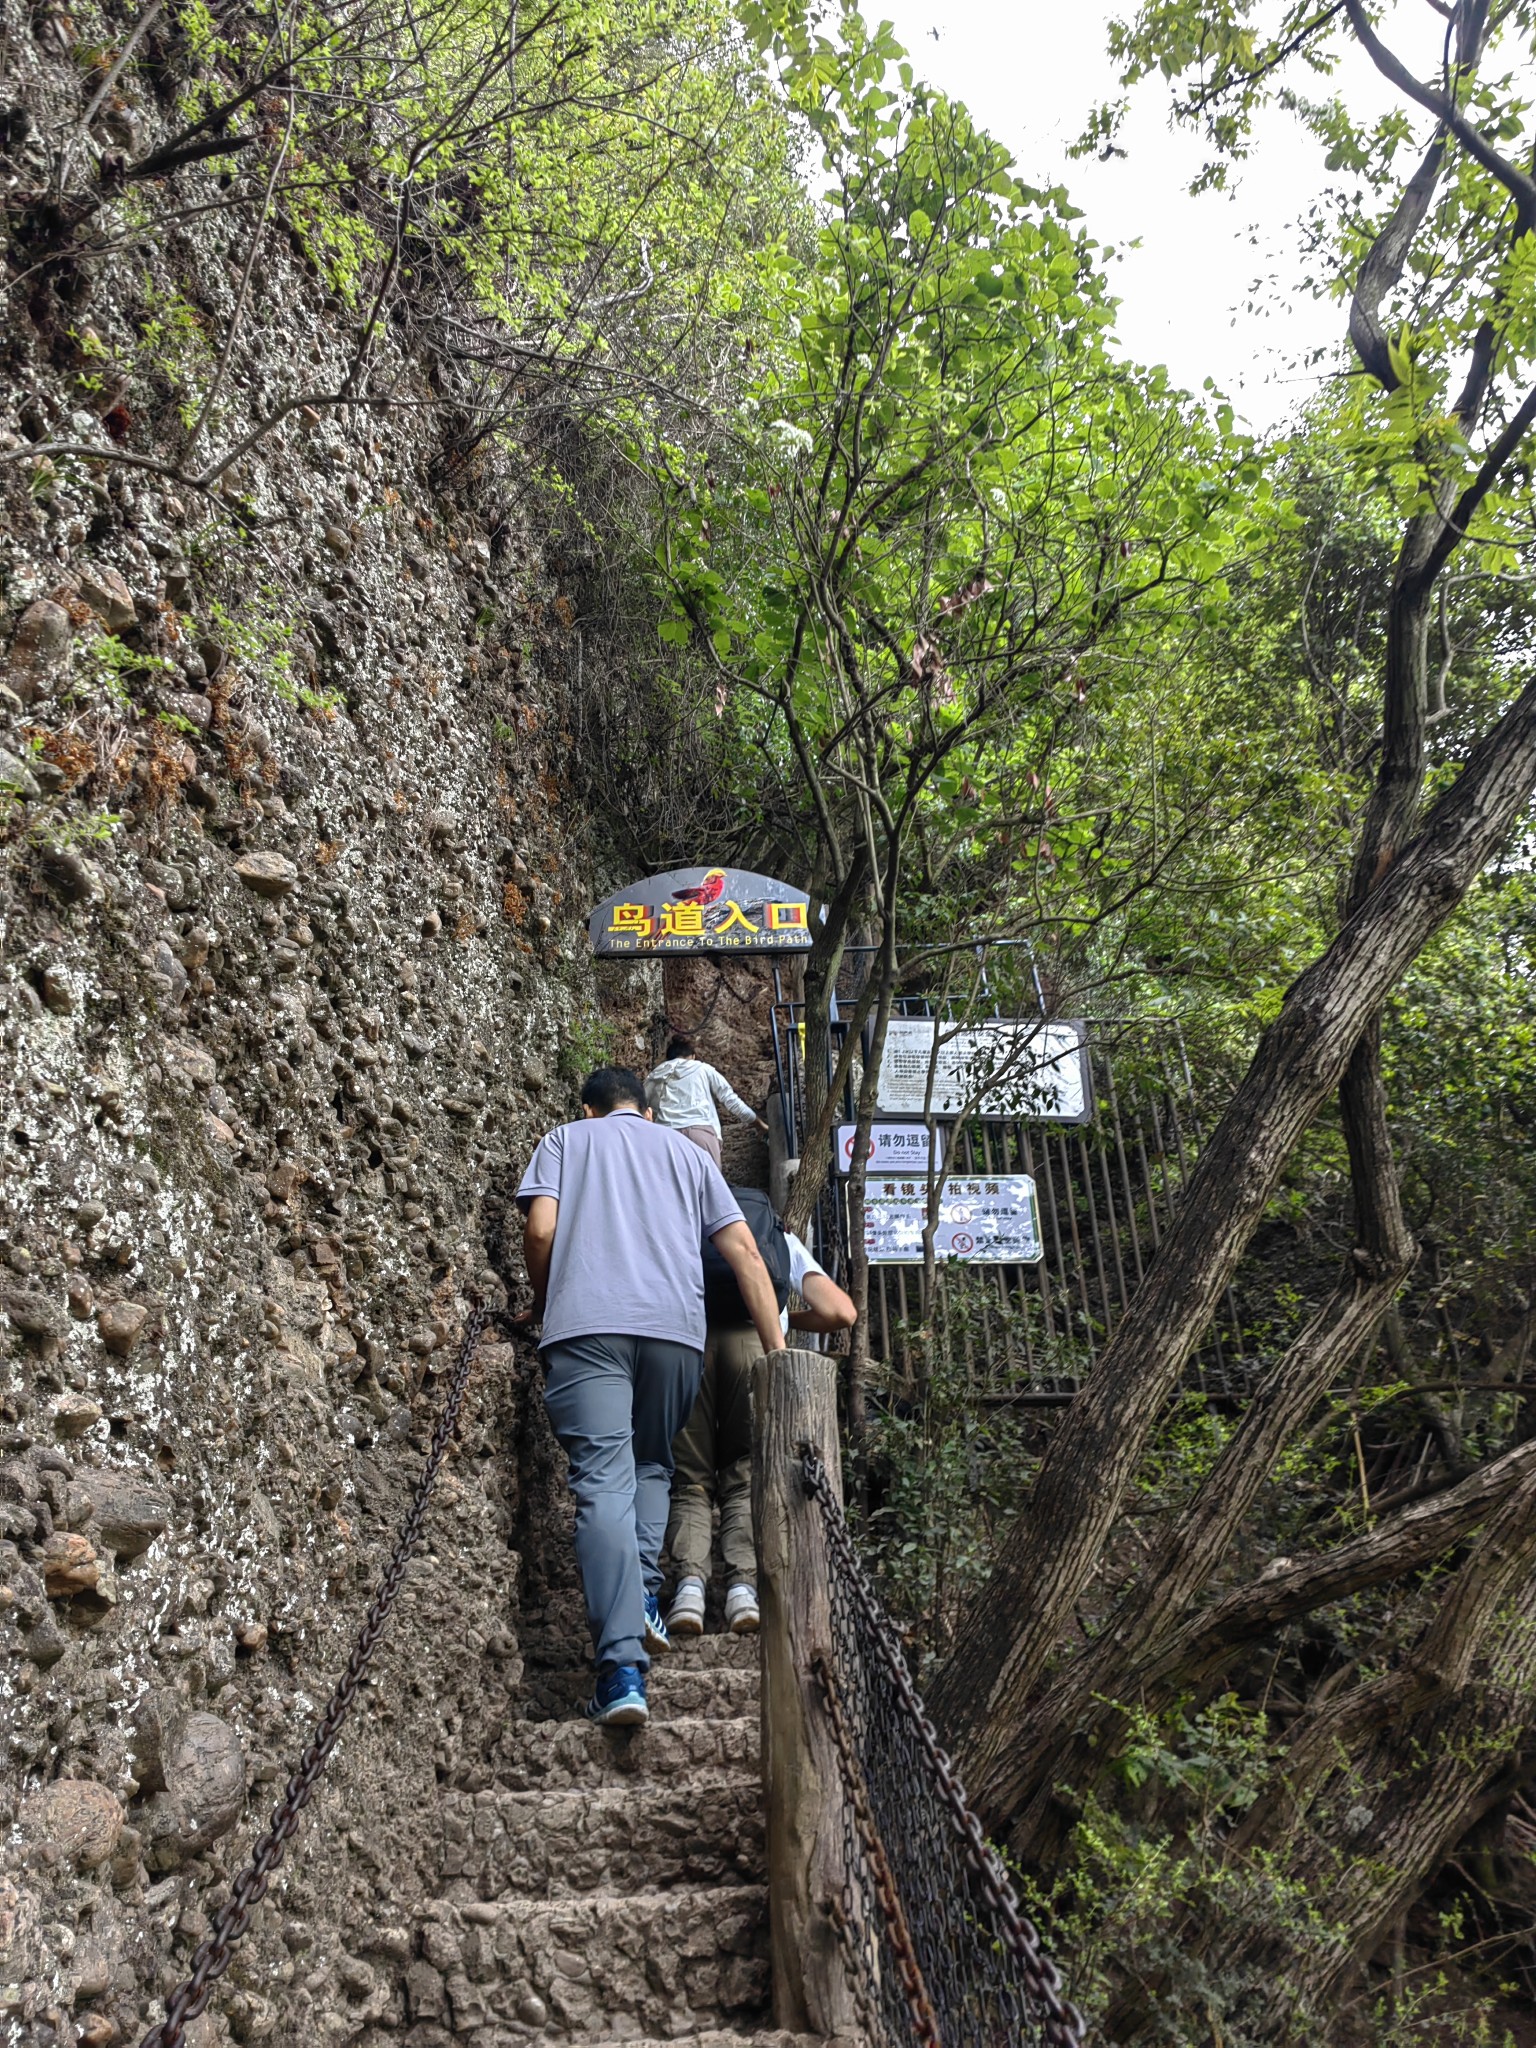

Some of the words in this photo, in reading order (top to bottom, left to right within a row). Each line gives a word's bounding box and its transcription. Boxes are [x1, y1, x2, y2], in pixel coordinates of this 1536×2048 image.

[607, 900, 808, 937] 鸟道入口
[610, 939, 630, 949] The
[636, 937, 694, 949] Entrance
[699, 936, 713, 947] To
[718, 936, 740, 946] The
[745, 935, 774, 946] Bird
[778, 935, 808, 945] Path
[878, 1133, 931, 1147] 请勿逗留
